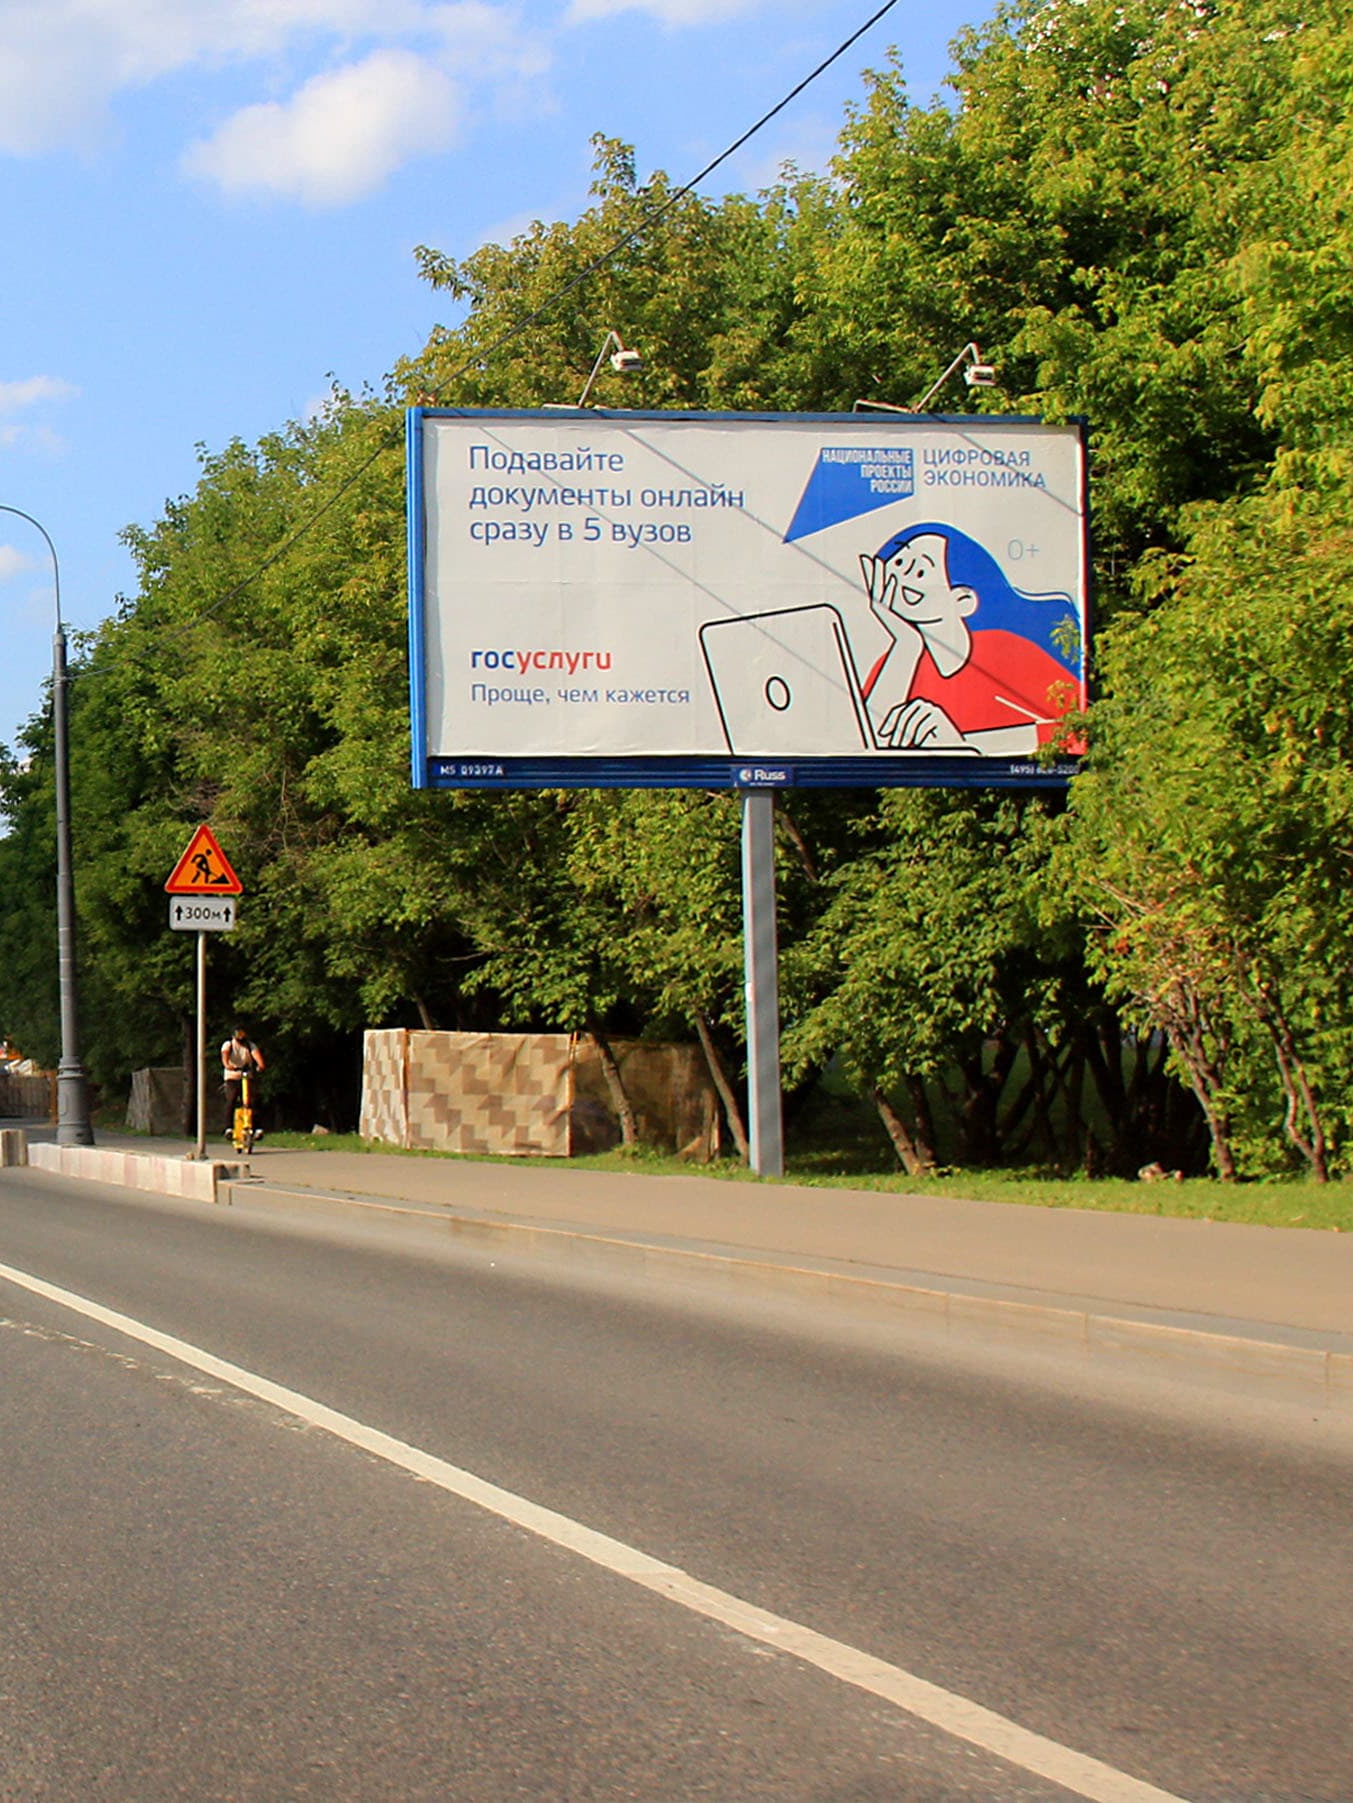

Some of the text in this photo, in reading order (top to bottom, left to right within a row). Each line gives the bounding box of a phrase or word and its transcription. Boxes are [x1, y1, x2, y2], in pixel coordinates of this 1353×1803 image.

[469, 446, 625, 475] Подавайте
[822, 449, 913, 465] НАЦИОНАЛЬНЫЕ
[923, 449, 1031, 467] ЦИФРОВАЯ
[860, 464, 913, 479] ПРОЕКТЫ
[923, 470, 1046, 488] ЭКОНОМИКА
[870, 479, 913, 494] РОССИИ
[469, 483, 745, 512] документы онлайн
[469, 517, 692, 549] сразу в 5 вузов
[1006, 539, 1039, 561] 0+
[471, 650, 611, 675] госуслуги
[471, 684, 690, 706] Проще, чем кажется
[754, 769, 786, 781] Russ
